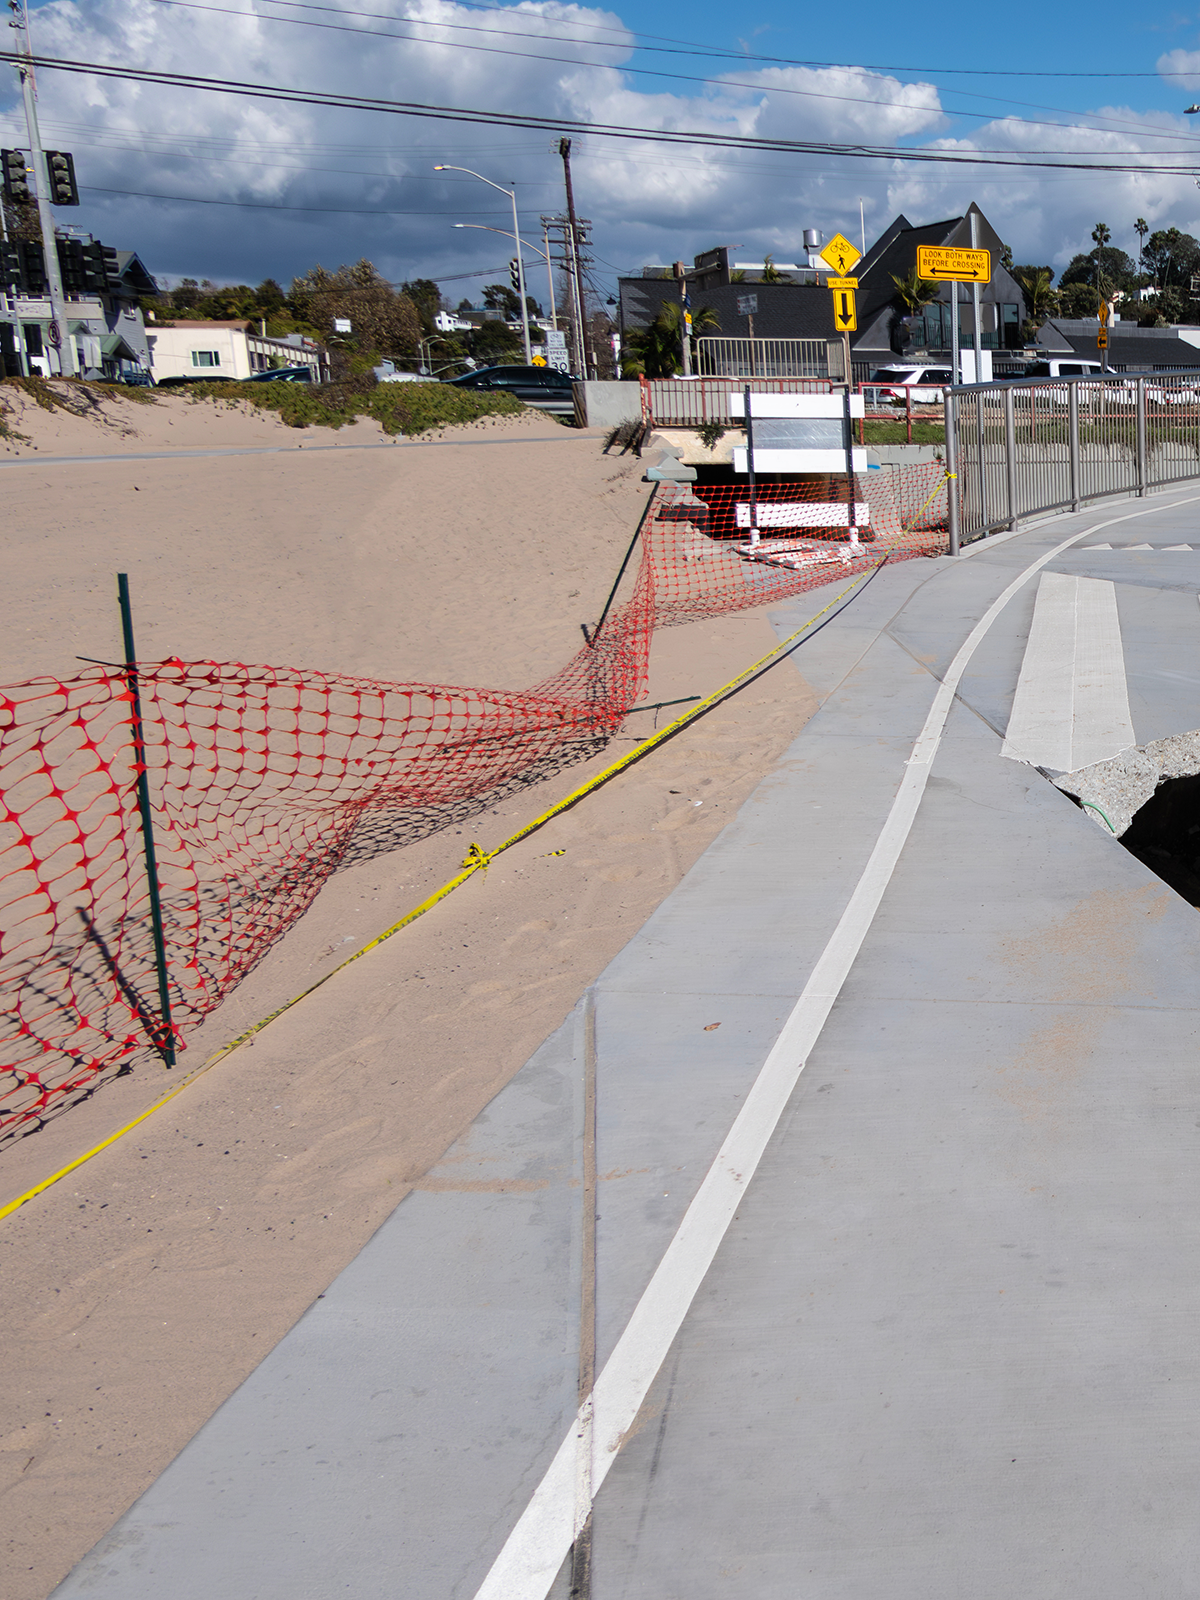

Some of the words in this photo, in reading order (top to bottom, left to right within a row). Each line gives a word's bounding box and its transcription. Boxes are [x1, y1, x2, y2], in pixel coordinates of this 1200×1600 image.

[924, 250, 943, 258] LOOK
[945, 251, 963, 260] BOTH
[965, 253, 984, 261] WAYS
[922, 258, 950, 267] BEFORE
[952, 260, 985, 269] CROSSING
[551, 361, 568, 372] 30
